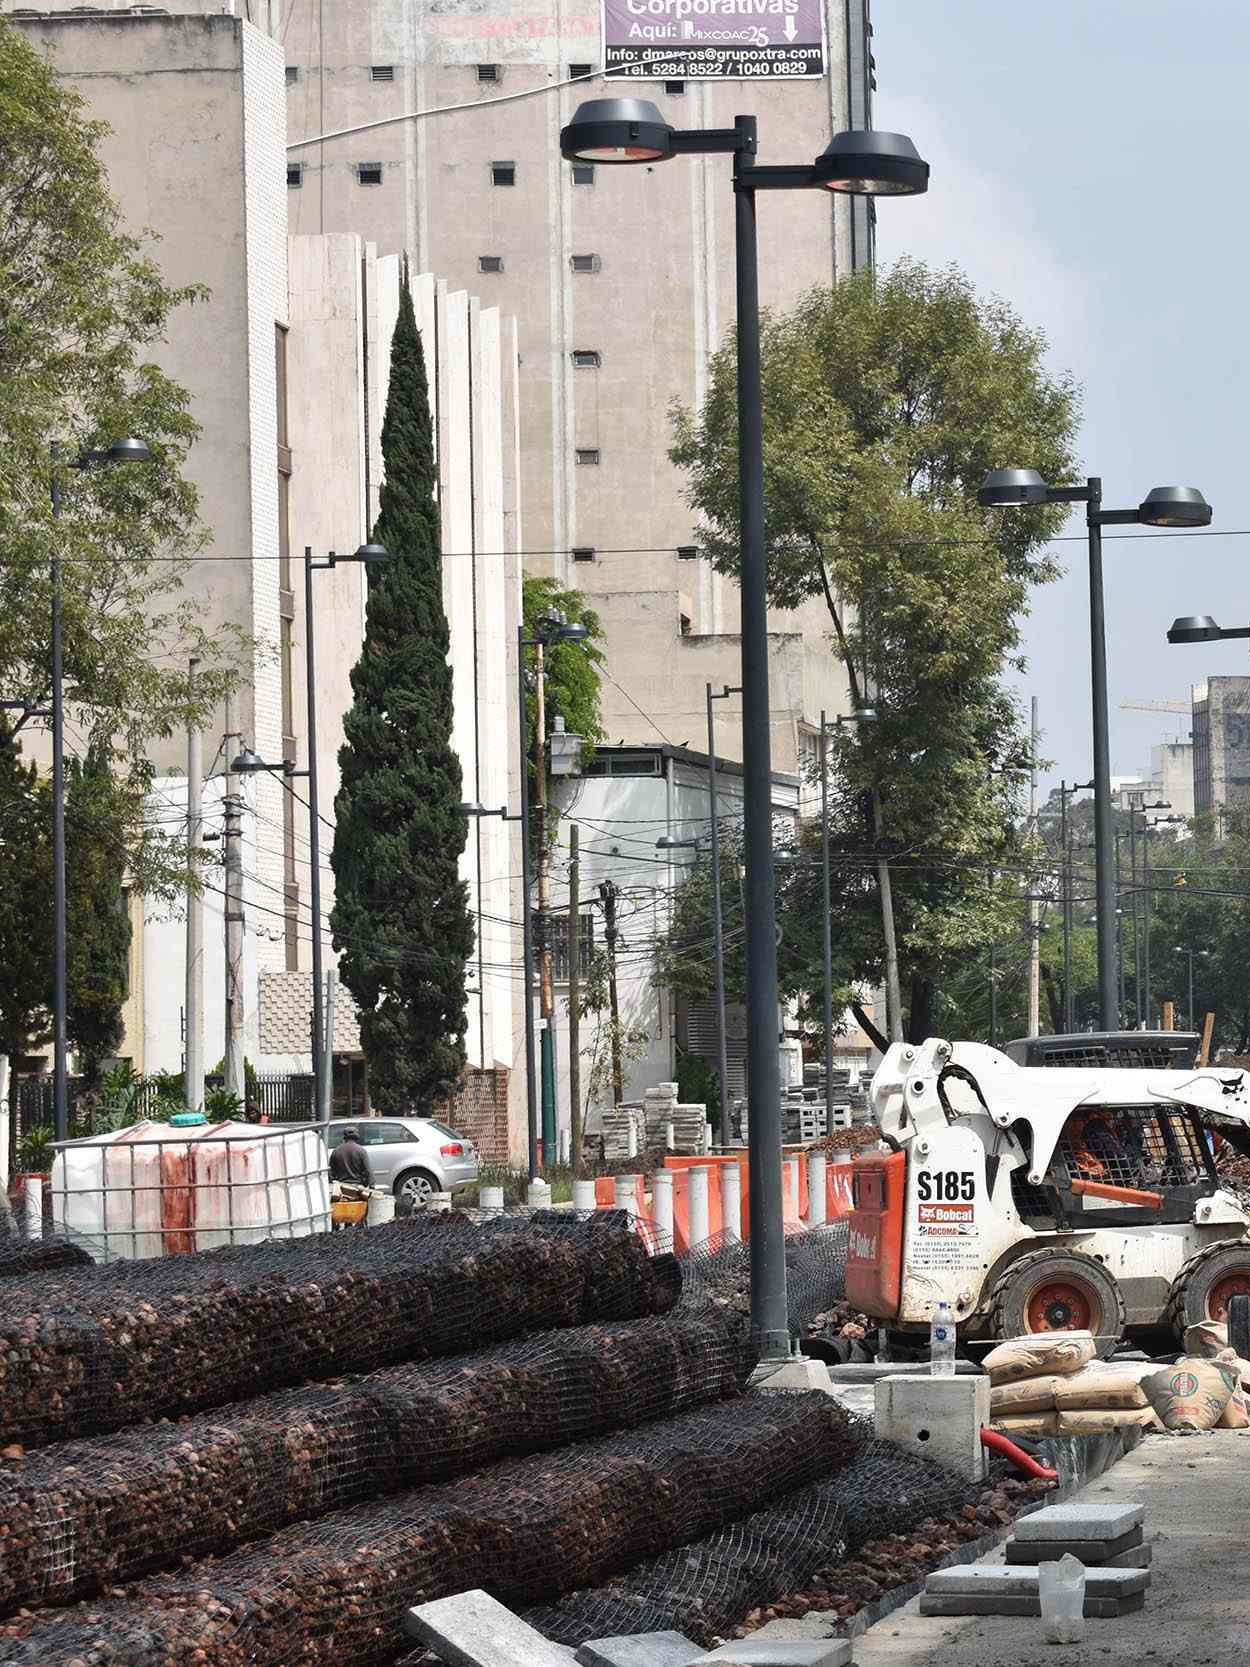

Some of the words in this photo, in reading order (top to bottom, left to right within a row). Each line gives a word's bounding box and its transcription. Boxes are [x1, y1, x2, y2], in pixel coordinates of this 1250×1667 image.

[627, 0, 799, 19] Corporativas
[628, 22, 676, 41] Aquí:
[607, 48, 638, 61] Info:
[622, 63, 648, 75] Tel.
[652, 63, 685, 75] 5284
[688, 62, 723, 75] 8522
[737, 62, 769, 75] 1040
[773, 61, 807, 74] 0829
[917, 1171, 976, 1201] S185
[935, 1208, 973, 1221] Bobcat
